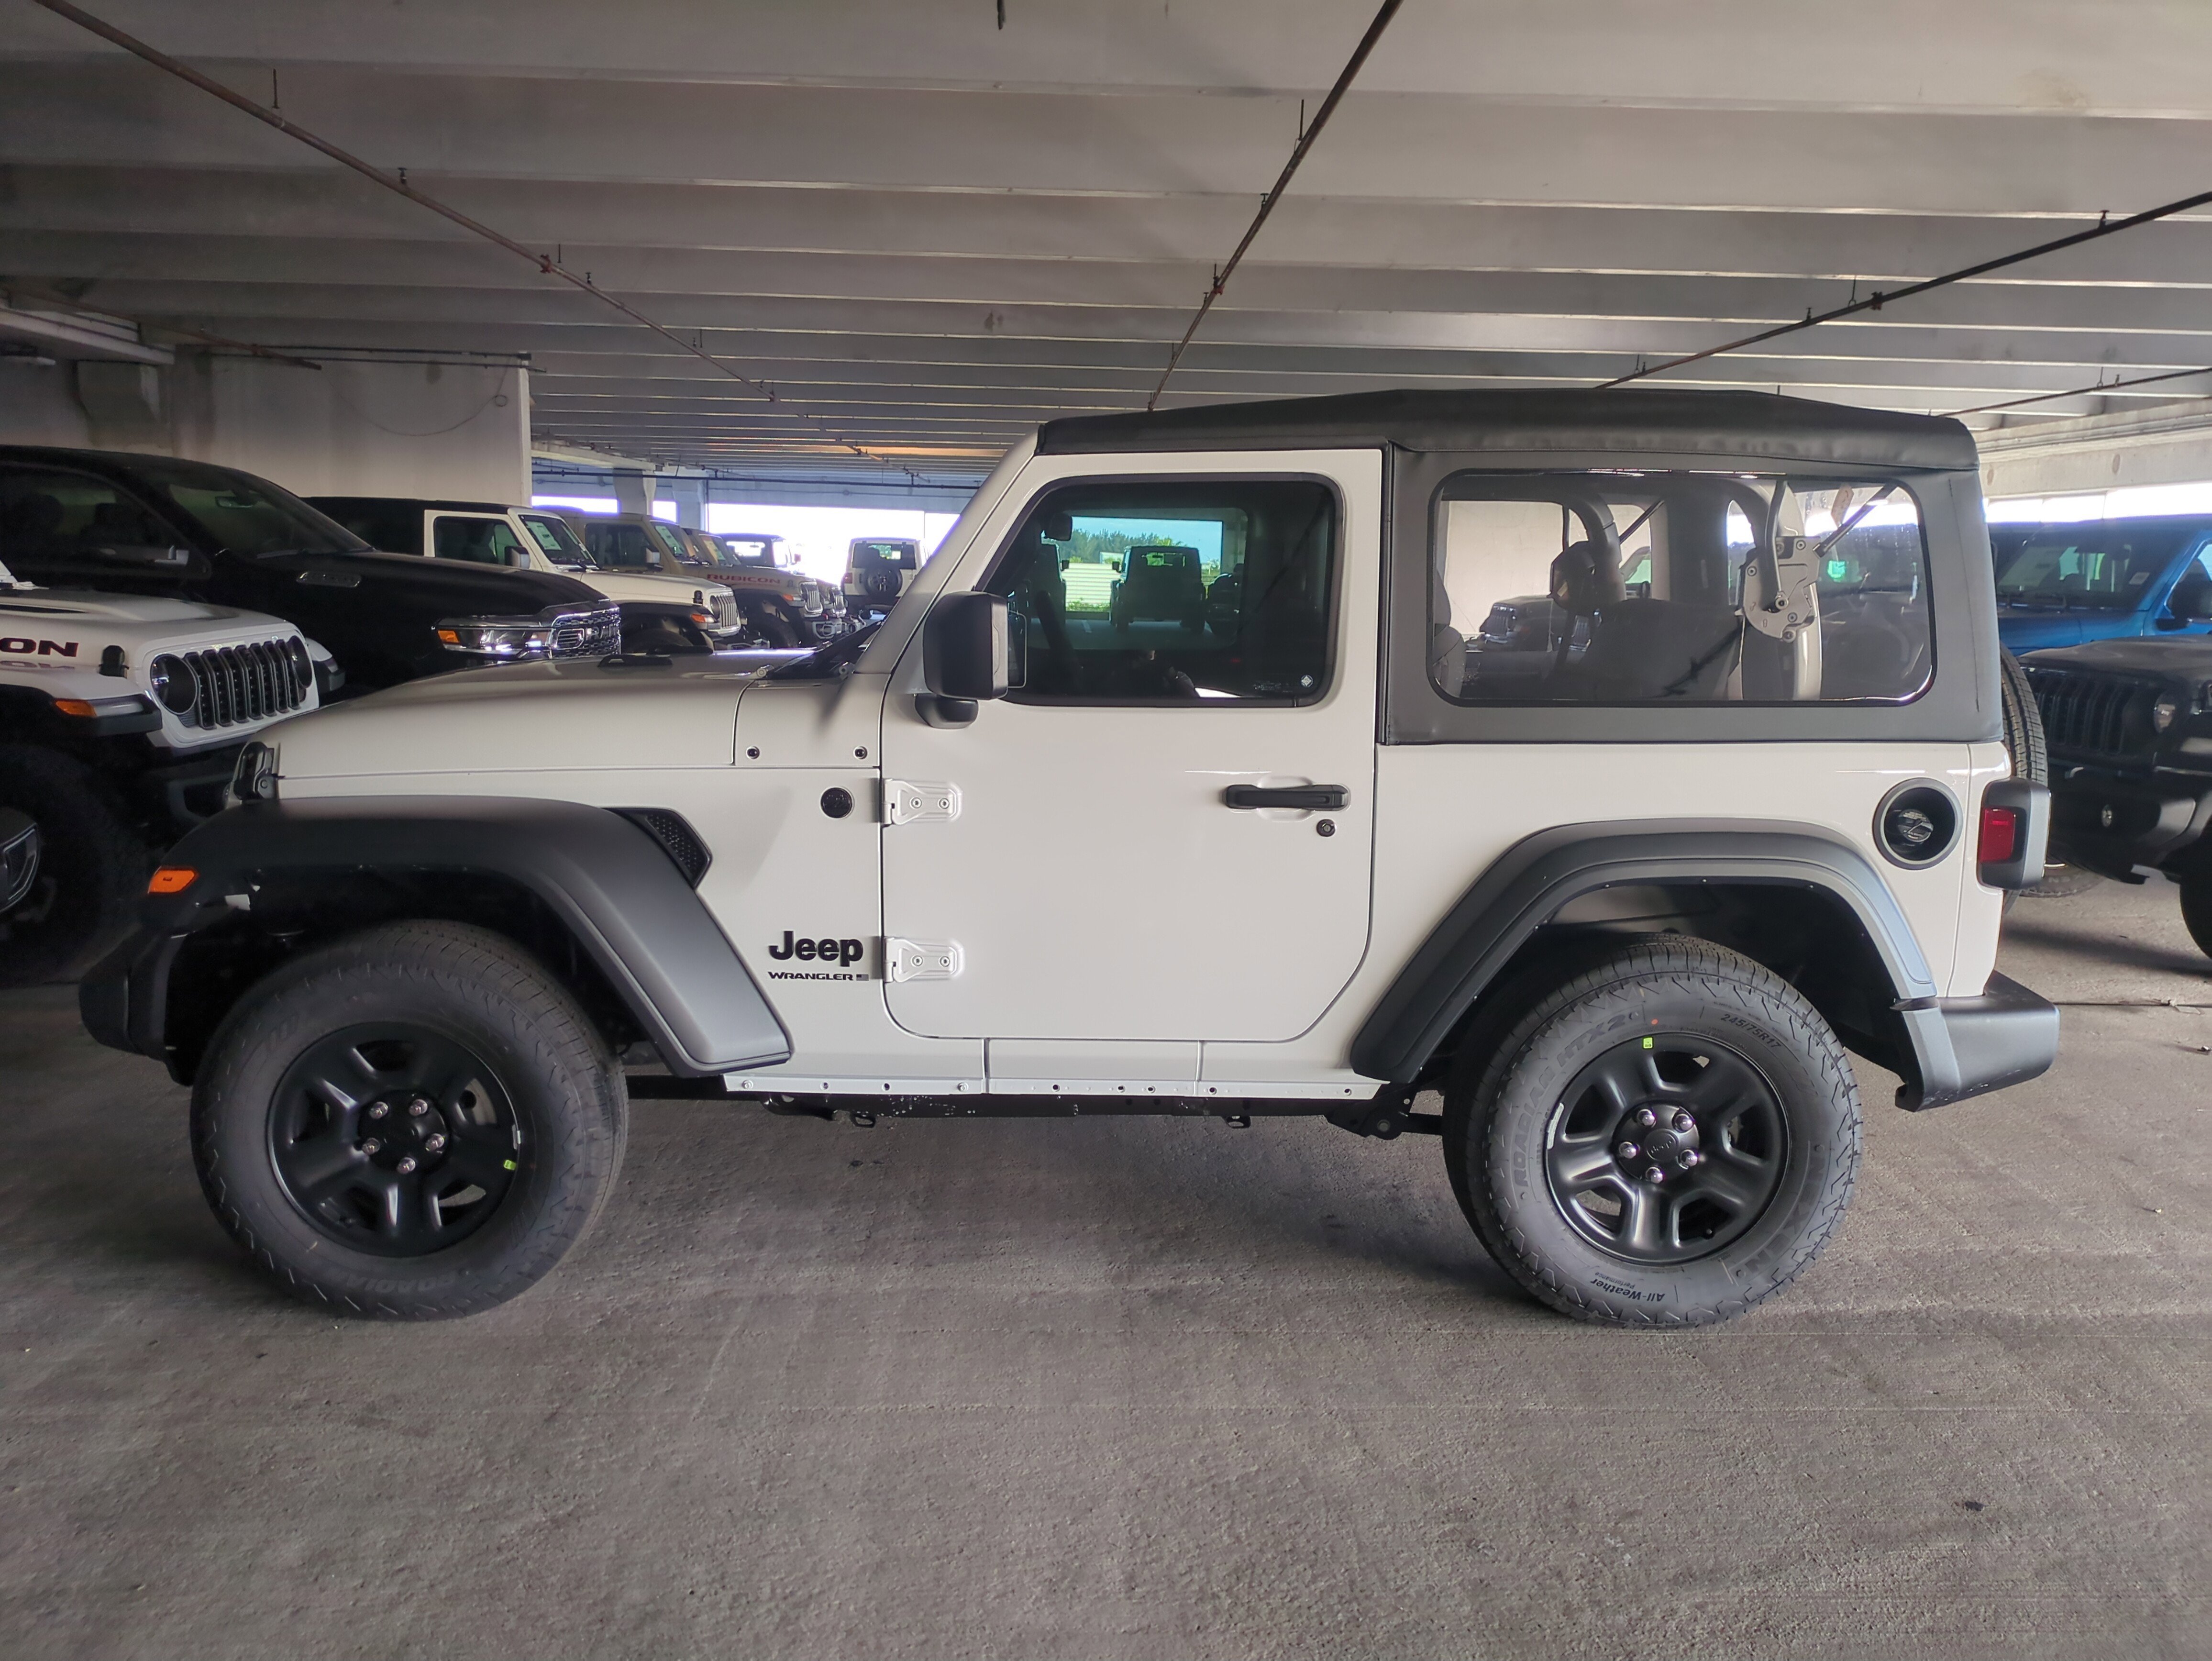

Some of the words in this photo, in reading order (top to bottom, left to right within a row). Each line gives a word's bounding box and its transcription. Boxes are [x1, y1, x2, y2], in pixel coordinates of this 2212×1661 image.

[706, 574, 780, 584] RUBICON
[768, 930, 863, 967] Jeep
[768, 971, 853, 981] WRANGLER
[1720, 1013, 1782, 1048] 245/75R17
[1513, 1066, 1555, 1187] ROADIAN
[1557, 1013, 1626, 1068] HTX2
[1745, 1156, 1825, 1274] NEXEN
[1590, 1278, 1665, 1303] All-Weather
[1594, 1272, 1635, 1289] Performance
